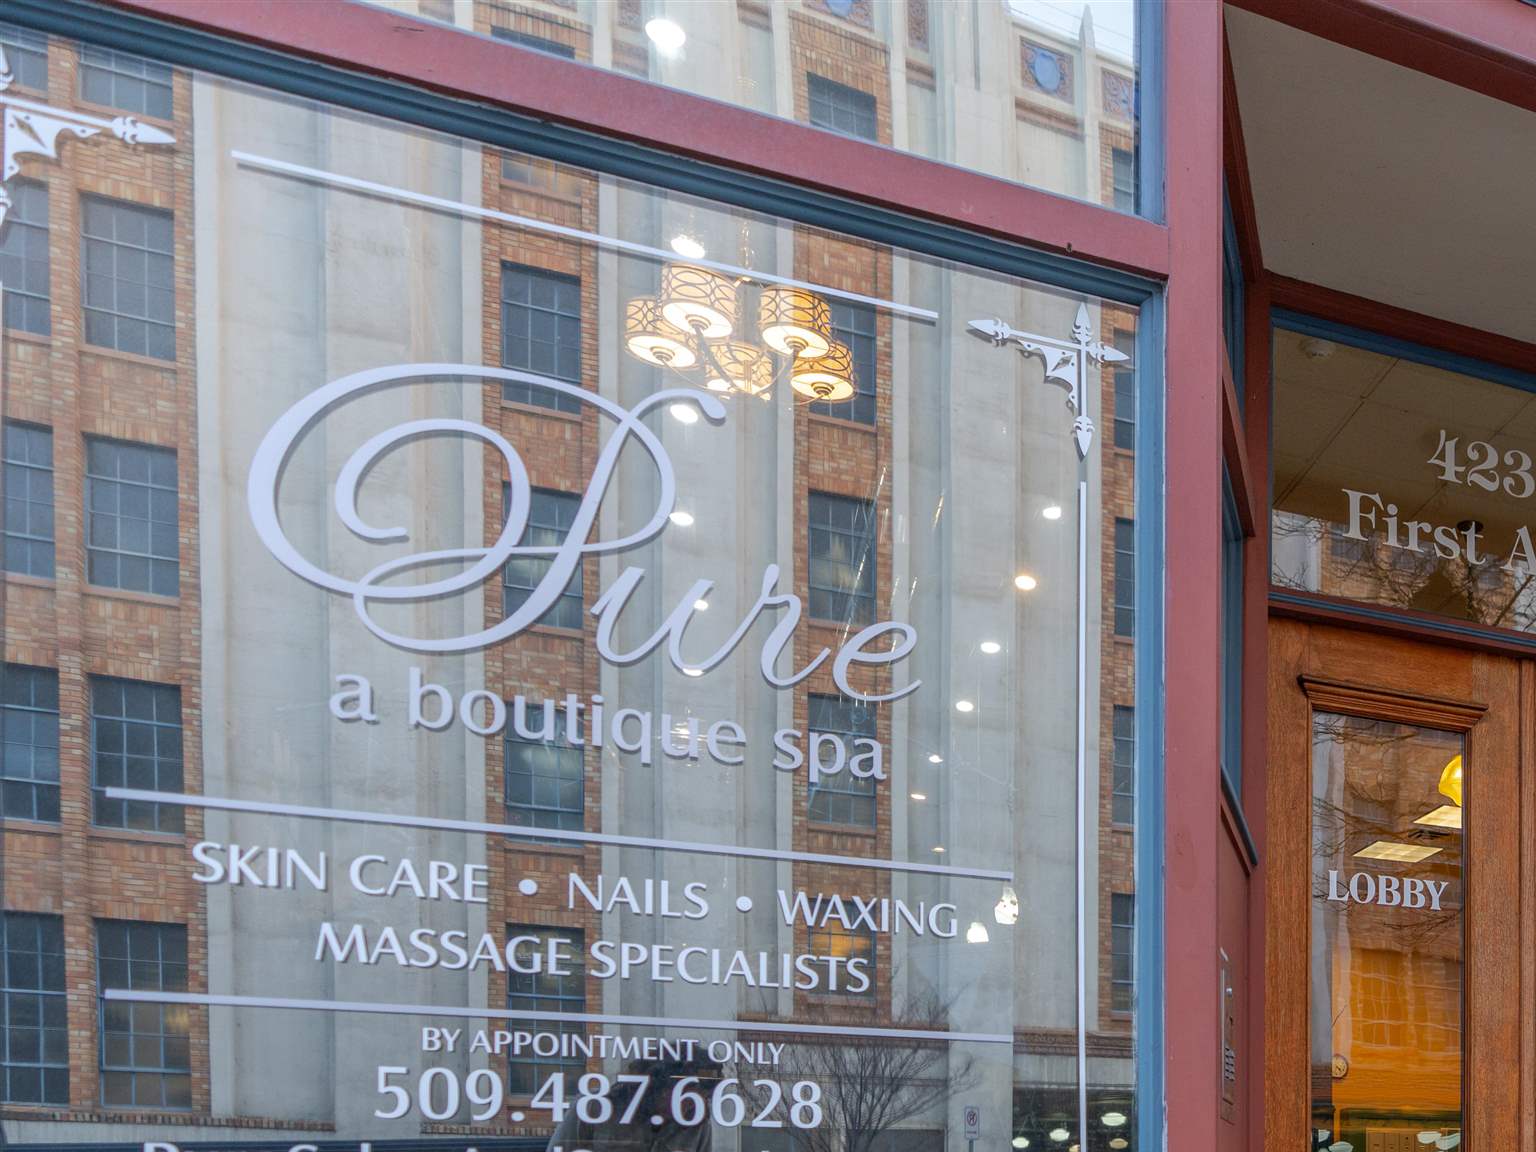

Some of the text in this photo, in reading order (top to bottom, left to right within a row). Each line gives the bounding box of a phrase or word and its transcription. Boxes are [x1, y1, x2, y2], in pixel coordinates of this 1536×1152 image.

[1427, 429, 1535, 499] 423
[247, 362, 922, 702] Pure
[1341, 488, 1487, 566] First
[329, 667, 887, 782] a boutique spa
[192, 841, 959, 938] SKIN CARE NAILS WAXING
[1327, 869, 1449, 911] LOBBY
[314, 921, 871, 994] MASSAGE SPECIALISTS
[422, 1026, 785, 1065] BY APPOINTMENT ONLY
[375, 1066, 824, 1129] 509.487.6628
